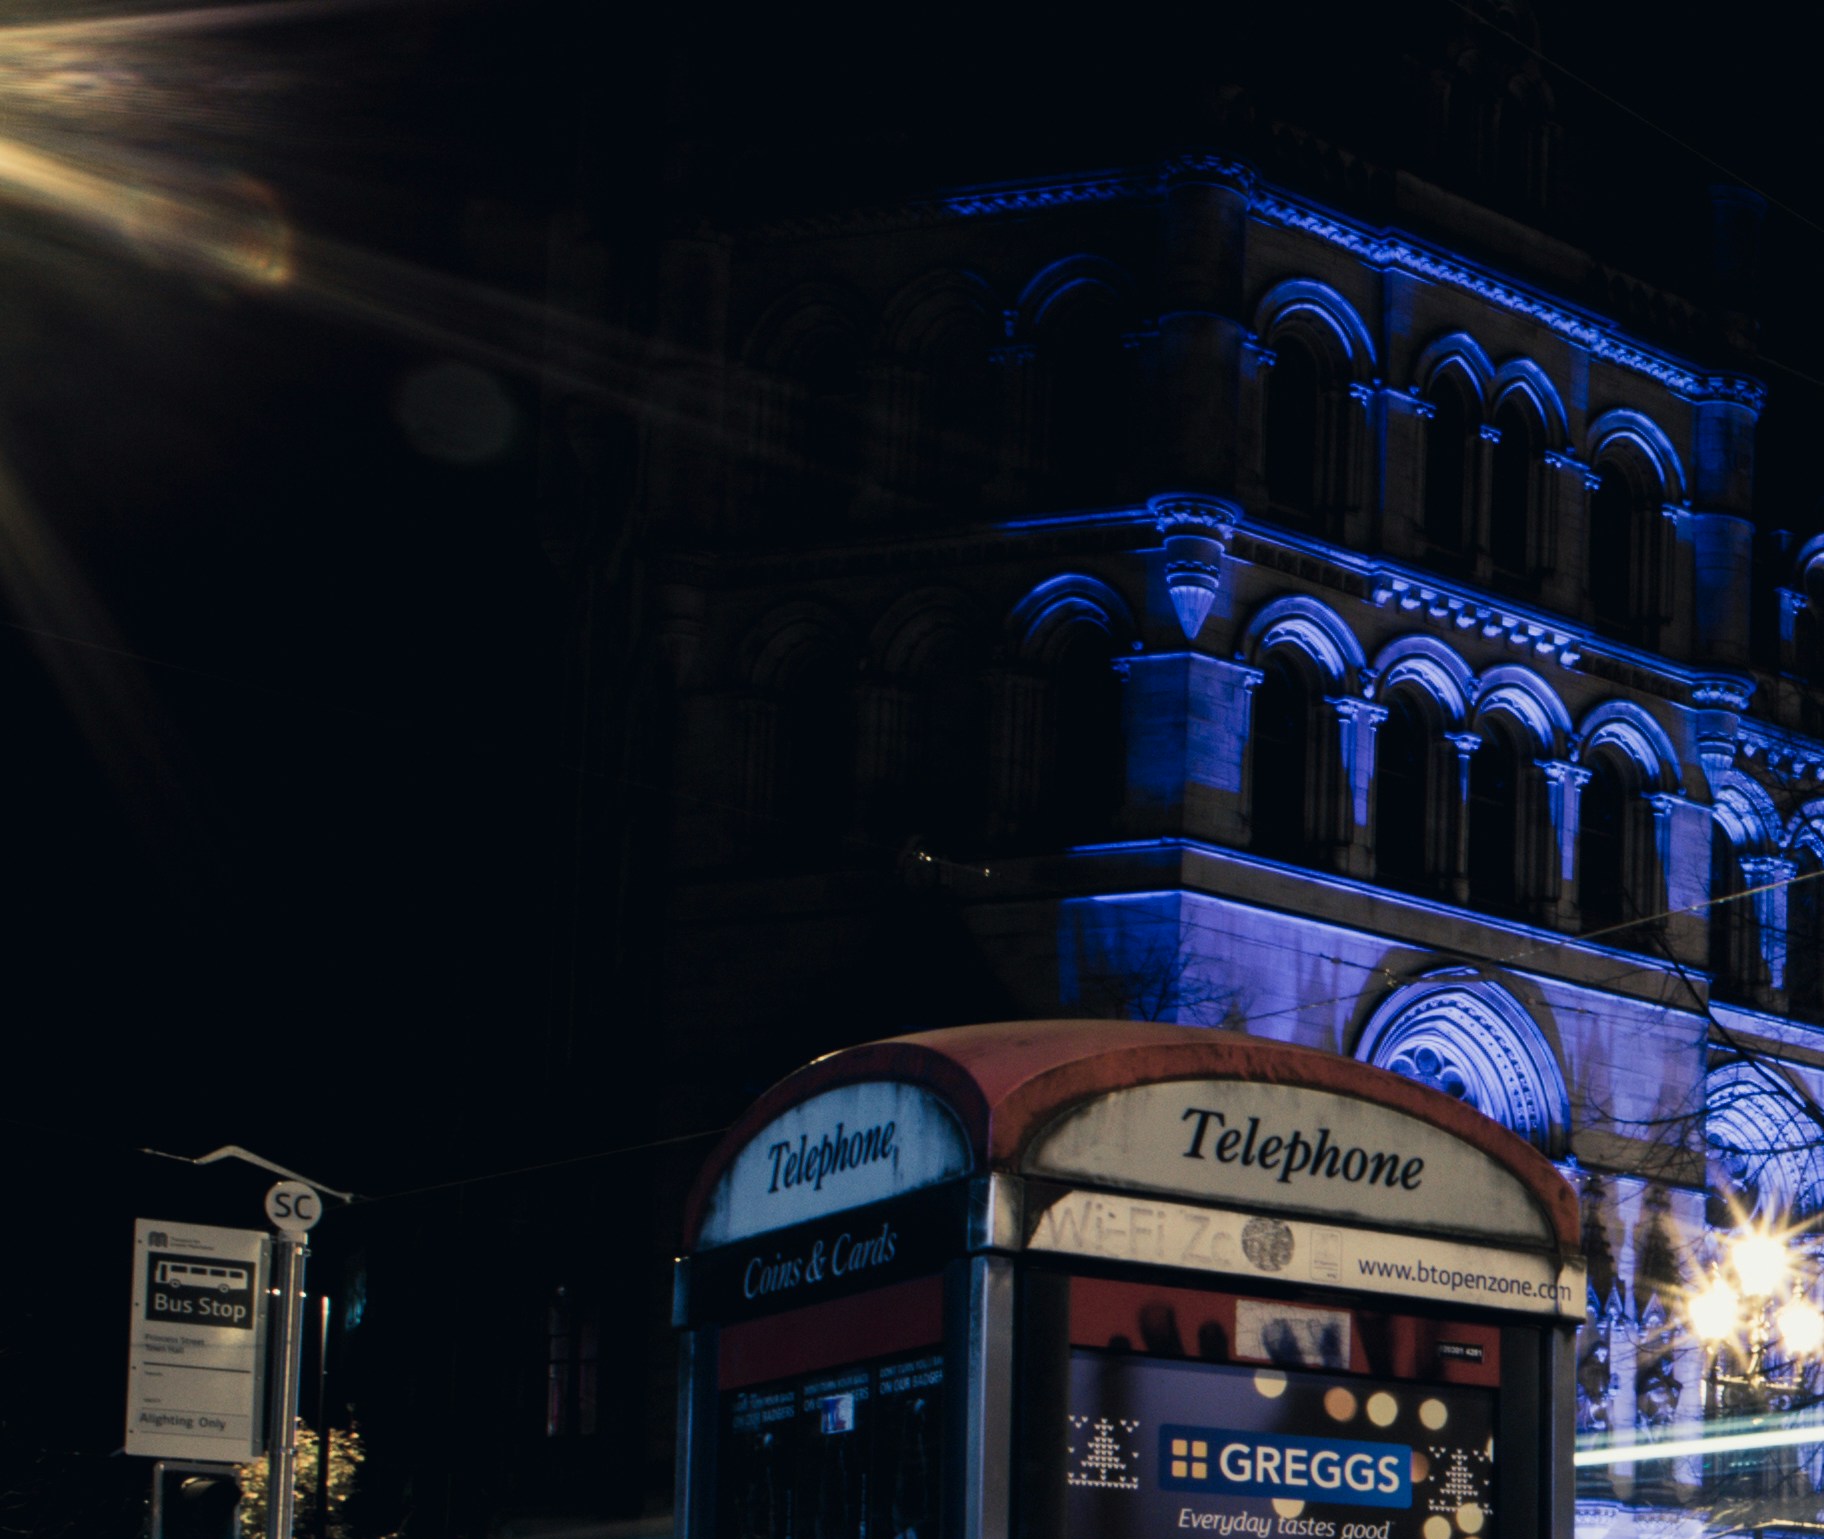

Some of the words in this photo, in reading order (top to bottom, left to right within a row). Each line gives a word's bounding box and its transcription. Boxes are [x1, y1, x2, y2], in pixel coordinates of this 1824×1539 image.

[767, 1121, 896, 1194] Telephone
[1181, 1107, 1426, 1191] Telephone
[274, 1192, 313, 1220] SC
[743, 1252, 803, 1300] Coins
[805, 1240, 828, 1284] &
[832, 1222, 898, 1276] Cards
[1358, 1258, 1572, 1302] www.btopenzone.com
[154, 1292, 193, 1314] Bus
[198, 1296, 247, 1323] Stop
[140, 1413, 194, 1429] Alighting
[197, 1416, 226, 1431] Only
[1219, 1442, 1400, 1493] GREGGS
[1178, 1507, 1272, 1539] Everyday
[1277, 1516, 1336, 1538] tastes
